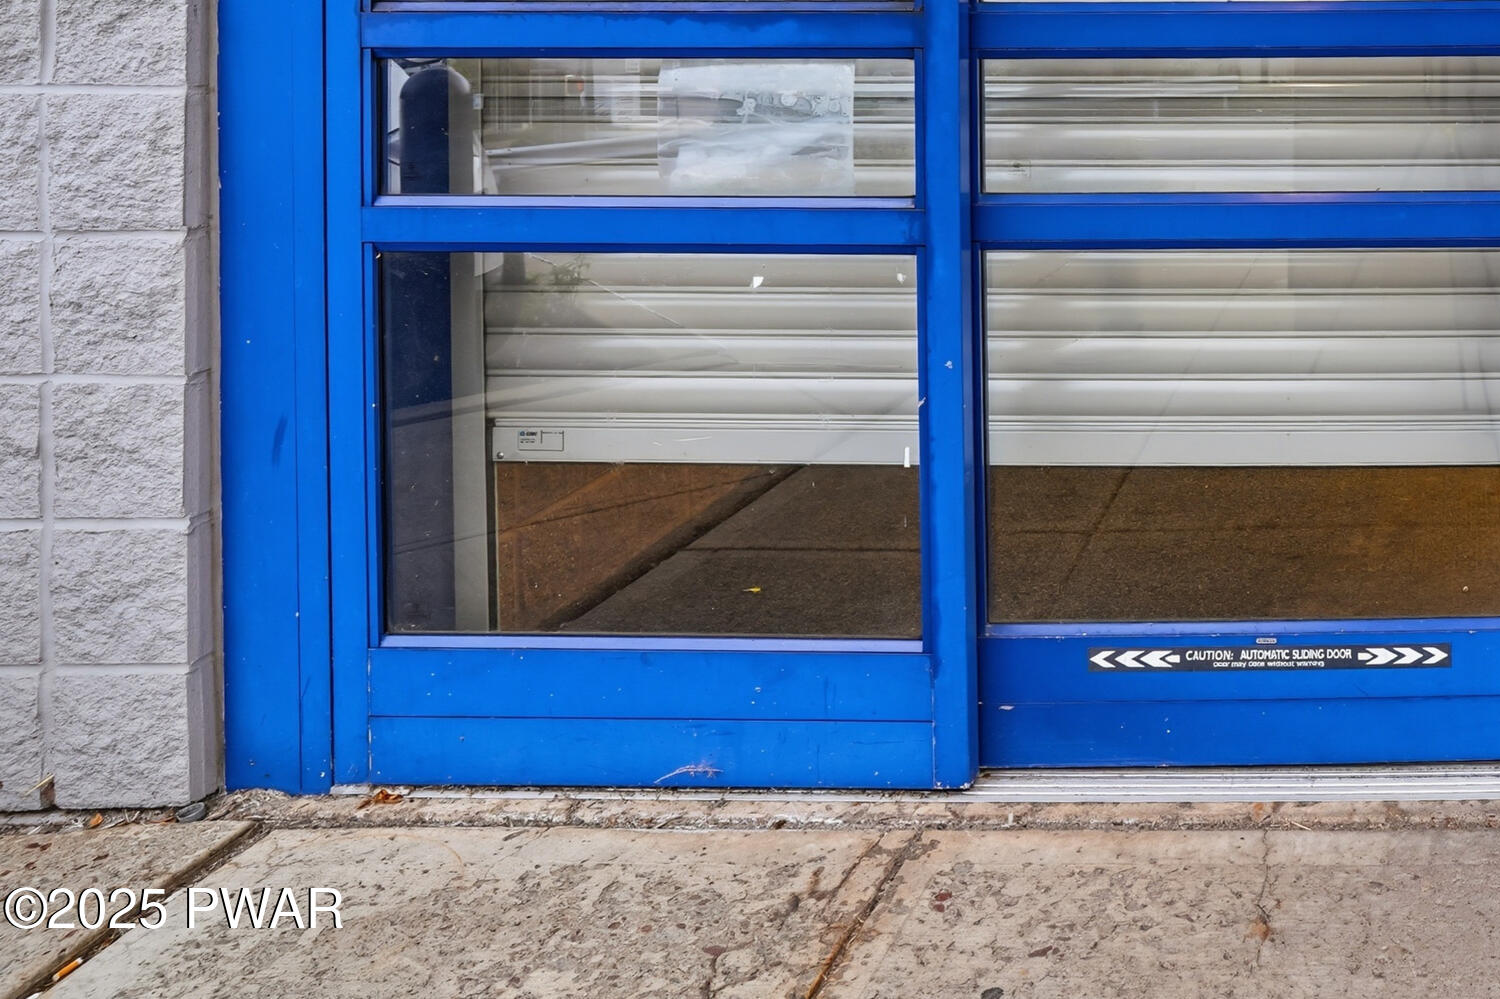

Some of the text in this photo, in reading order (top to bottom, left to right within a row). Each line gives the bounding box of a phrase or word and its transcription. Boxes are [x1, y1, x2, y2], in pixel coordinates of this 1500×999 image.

[1185, 649, 1352, 661] CAUTION: AUTOMATIC SLIDING DOOR
